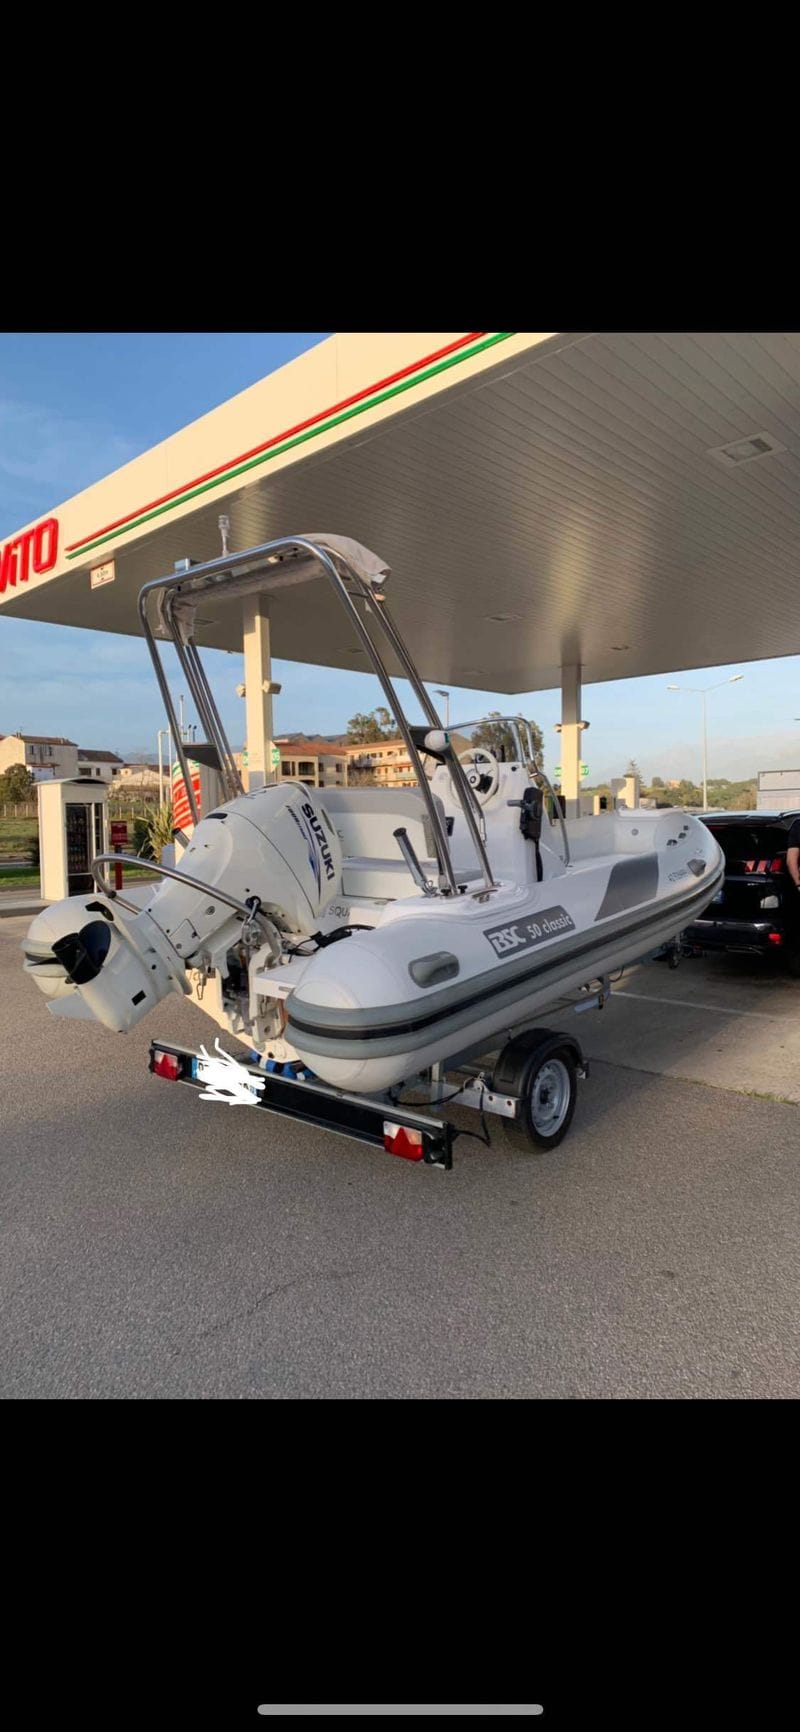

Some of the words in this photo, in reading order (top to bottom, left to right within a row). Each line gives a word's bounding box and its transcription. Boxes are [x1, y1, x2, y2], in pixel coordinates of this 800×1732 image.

[301, 803, 336, 881] SUZUKI
[488, 925, 527, 953] BSC
[526, 924, 543, 940] 50
[543, 913, 573, 935] classic
